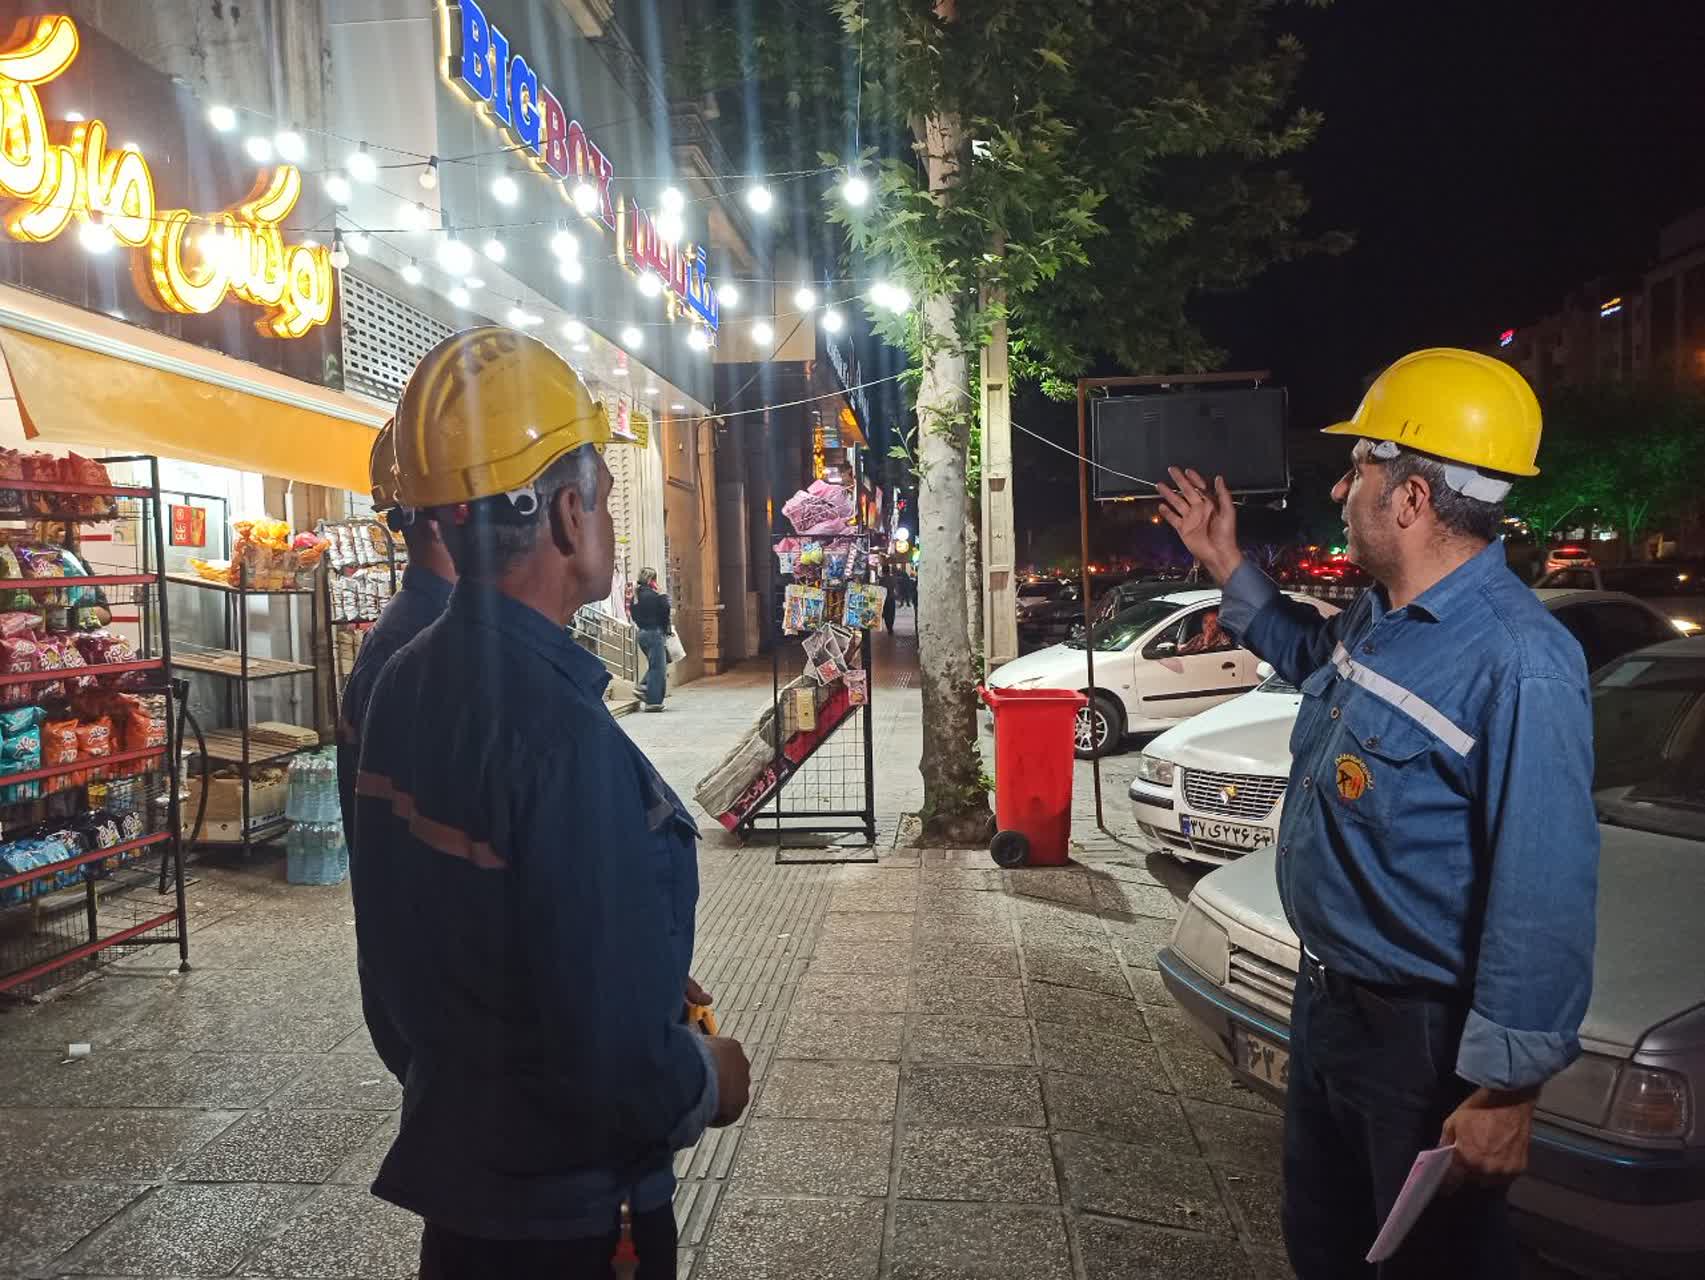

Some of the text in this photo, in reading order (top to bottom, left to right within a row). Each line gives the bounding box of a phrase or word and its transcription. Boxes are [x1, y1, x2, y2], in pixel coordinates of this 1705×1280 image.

[0, 14, 334, 338] لوکس مارک
[456, 0, 617, 232] BIG BOX
